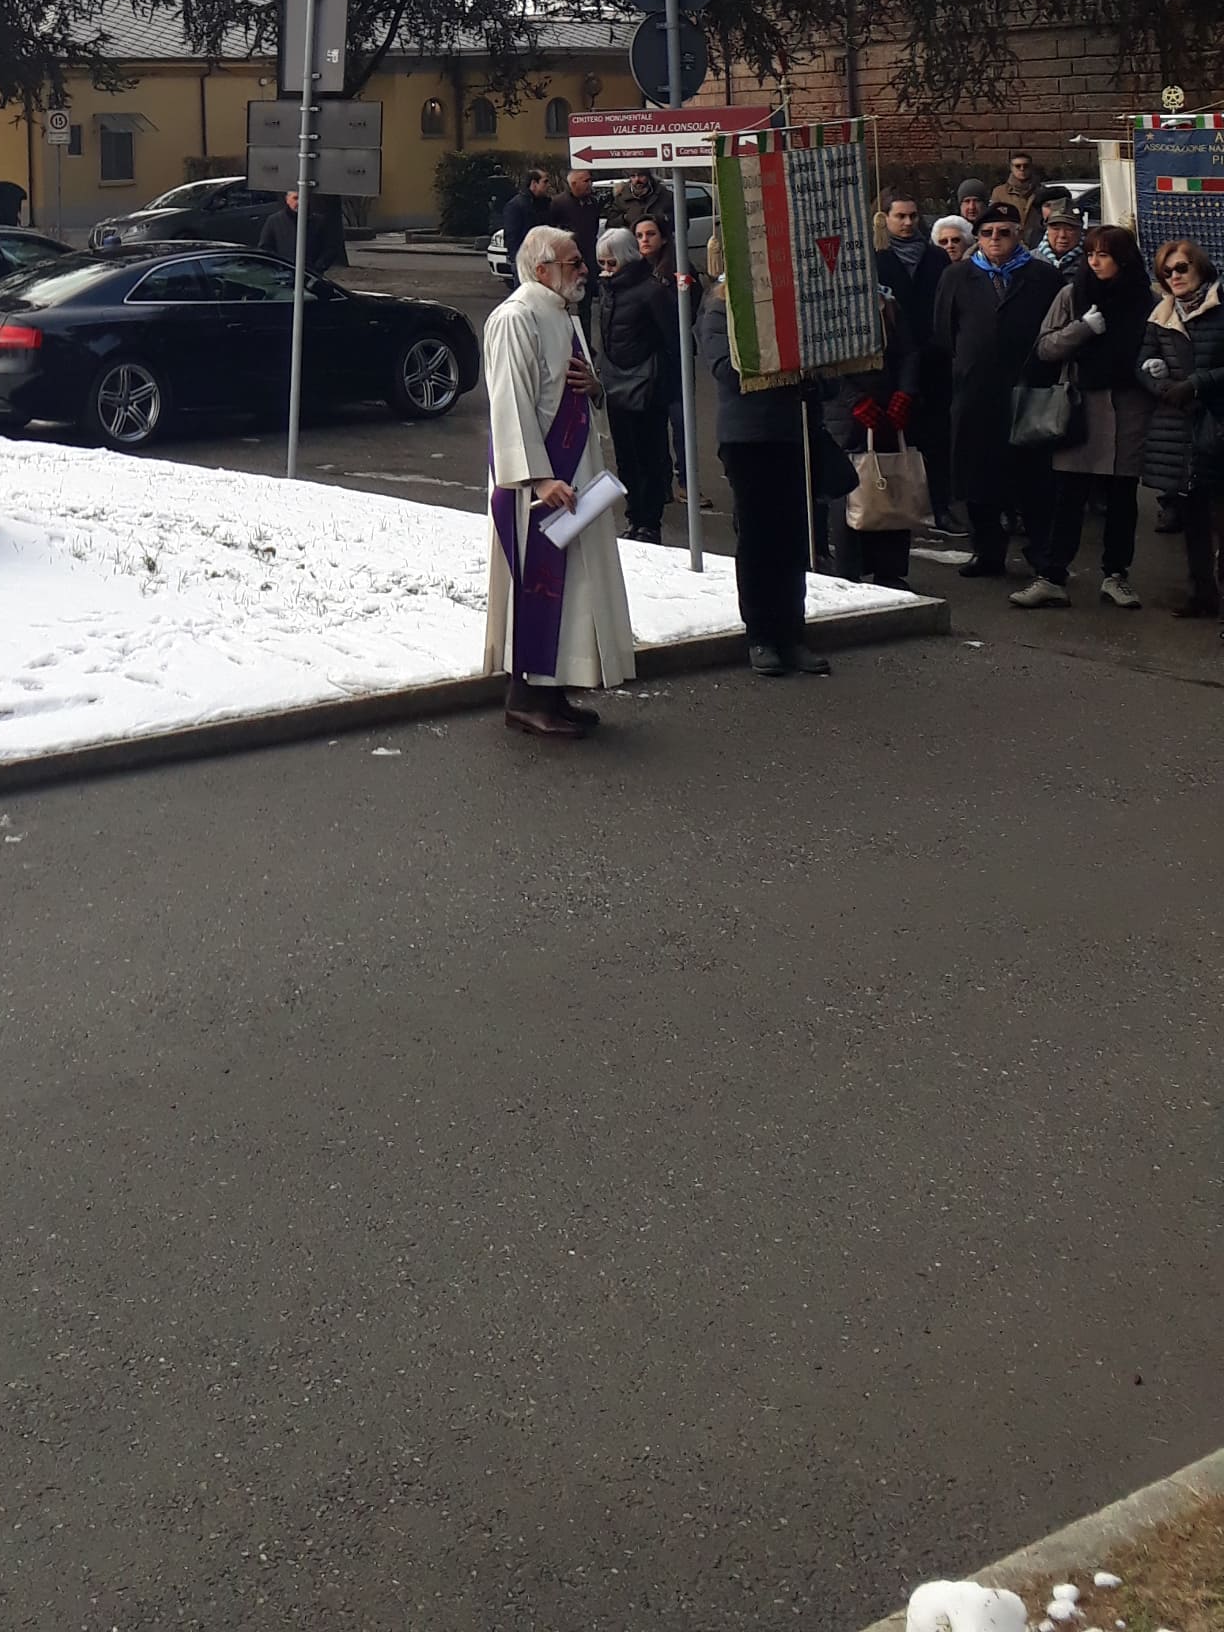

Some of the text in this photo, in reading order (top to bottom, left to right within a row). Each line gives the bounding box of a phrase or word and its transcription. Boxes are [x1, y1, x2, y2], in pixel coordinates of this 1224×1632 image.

[572, 113, 653, 124] CIMITERO MONUMENTALE
[612, 121, 721, 134] VIALE DELLA CONSOLATA
[679, 147, 697, 155] Corso
[1144, 143, 1207, 153] ASSOCIAZIONE
